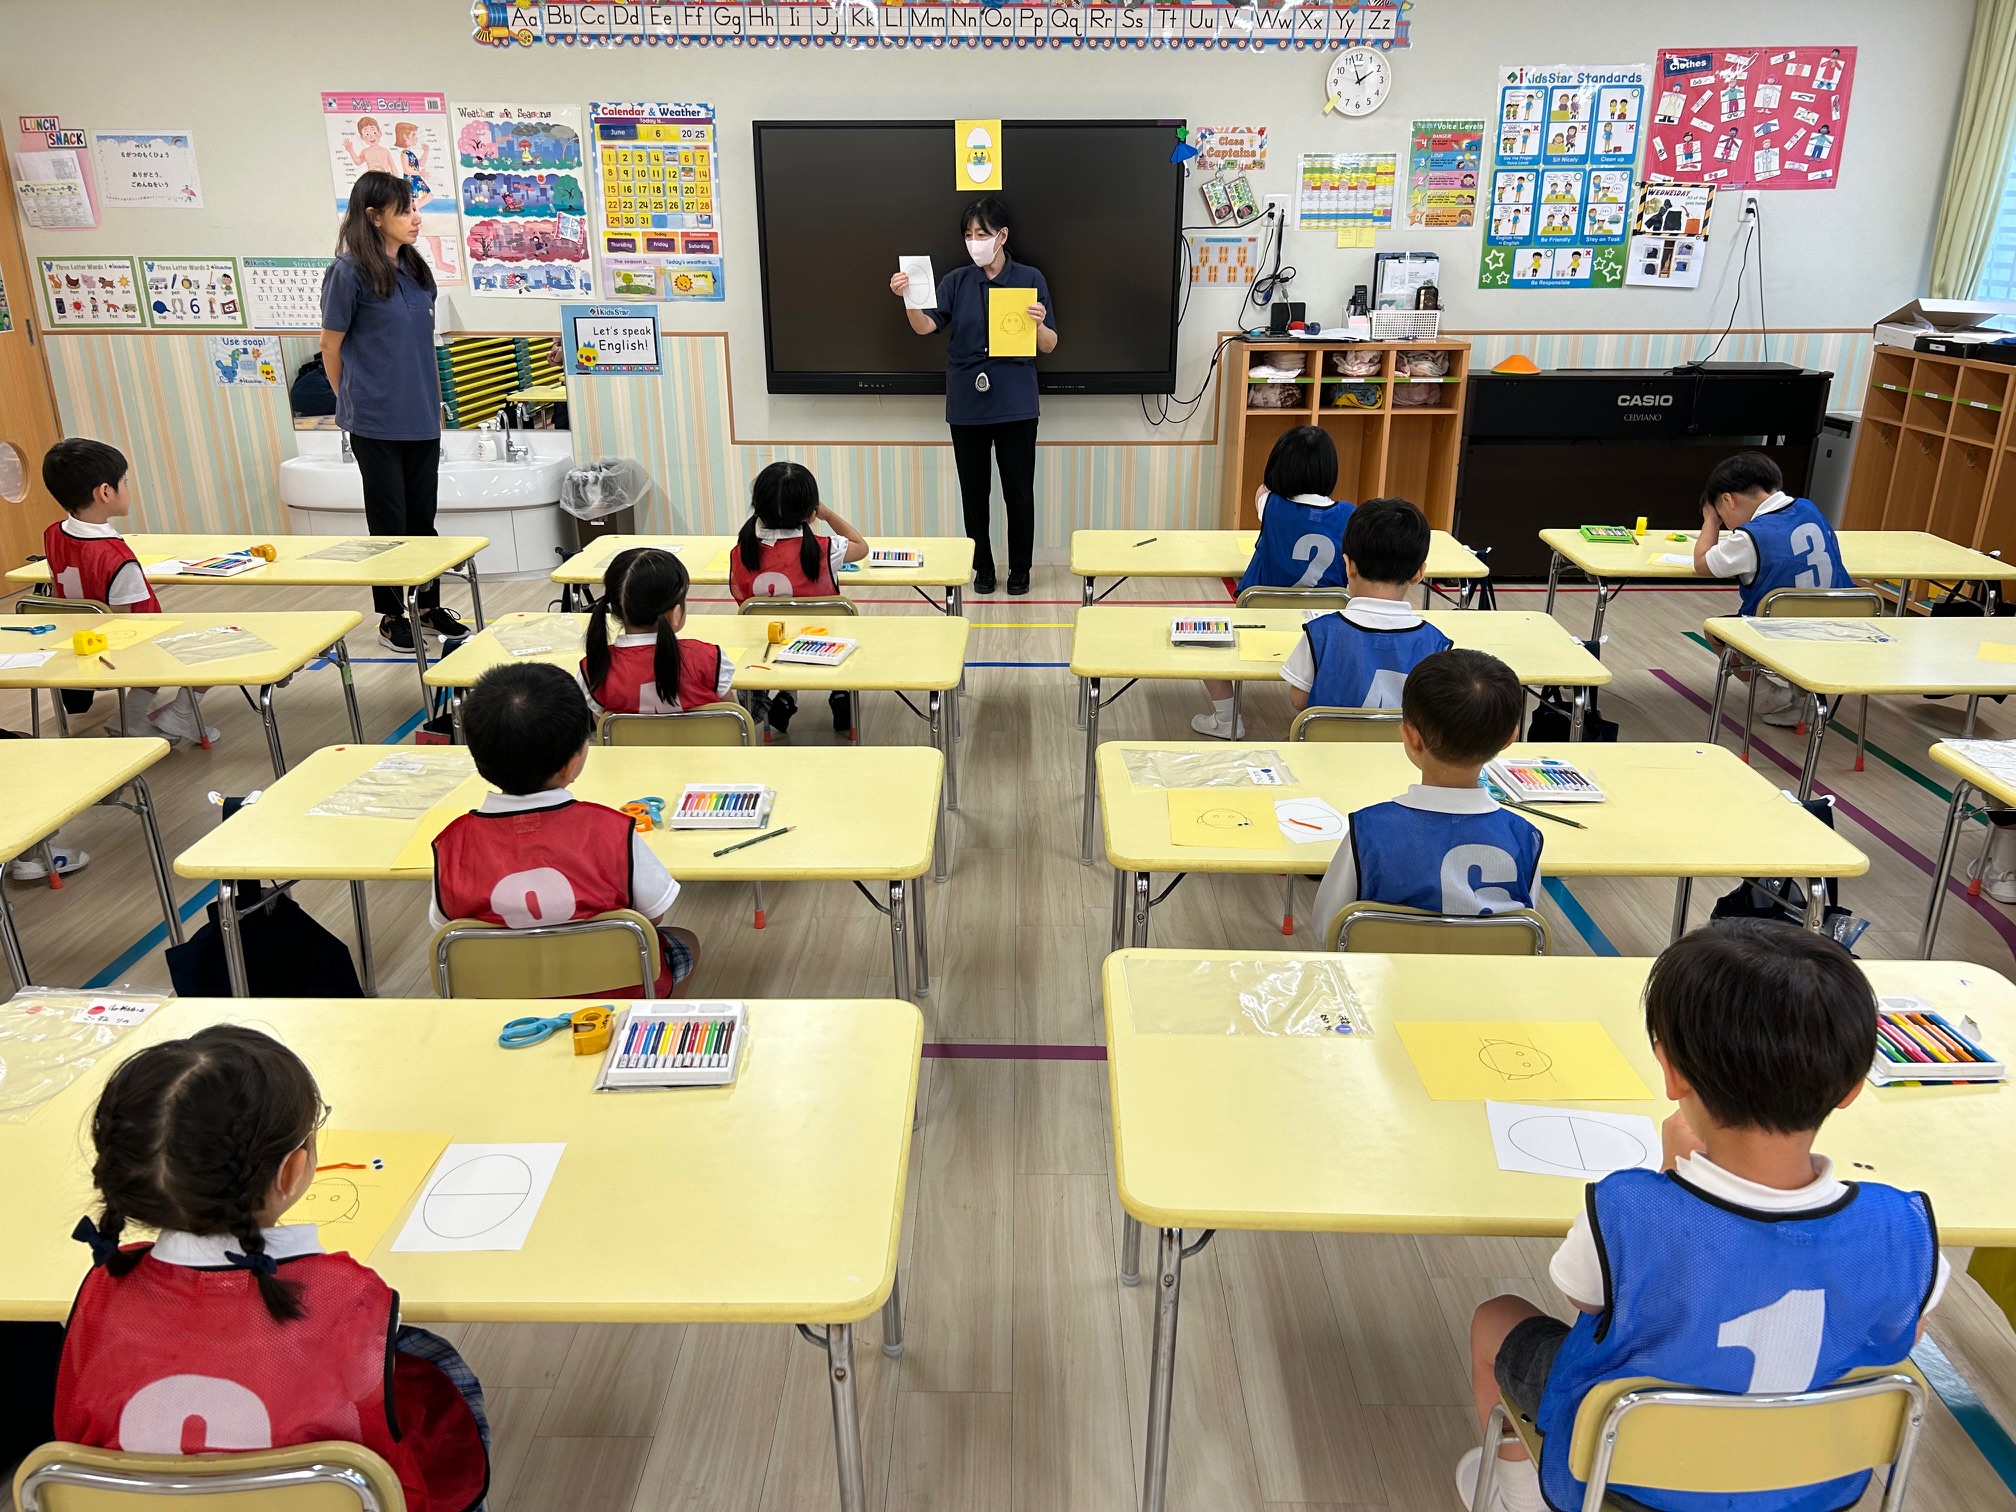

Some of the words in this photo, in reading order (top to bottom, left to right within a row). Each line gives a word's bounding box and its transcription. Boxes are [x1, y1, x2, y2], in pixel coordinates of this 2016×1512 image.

[511, 6, 538, 27] Aa
[547, 5, 573, 25] Bb
[580, 6, 605, 25] Cc
[613, 6, 639, 25] Dd
[651, 6, 672, 26] Ee
[684, 6, 704, 26] Ff
[714, 6, 741, 35] Gg
[748, 6, 774, 27] Hh
[789, 7, 800, 27] Ii
[816, 7, 839, 36] Jj
[852, 7, 875, 27] Kk
[886, 8, 903, 27] Ll
[911, 8, 945, 28] Mm
[952, 8, 977, 28] Nn
[984, 8, 1012, 28] Oo
[1020, 8, 1044, 37] Pp
[1052, 8, 1083, 37] Qq
[1090, 8, 1113, 28] Rr
[1122, 9, 1143, 28] Ss
[1157, 9, 1177, 29] Tt
[1189, 9, 1214, 29] Uu
[1256, 9, 1292, 30] Ww
[1298, 10, 1323, 30] Xx
[1335, 10, 1355, 39] Yy
[1368, 10, 1391, 30] Zz
[1670, 60, 1707, 71] Clothes
[1380, 76, 1383, 84] 3
[1577, 73, 1642, 84] Standards
[352, 98, 372, 112] My
[376, 98, 410, 113] Body
[457, 108, 494, 118] Weather
[518, 108, 551, 118] Seasons
[602, 107, 645, 116] Calendar
[649, 108, 655, 116] &
[659, 108, 700, 116] Weather
[24, 118, 57, 130] LUNCH
[49, 132, 84, 145] SNACK
[1219, 137, 1244, 146] Class
[1207, 147, 1256, 159] Captains
[1648, 189, 1691, 197] WEDNESDAY
[593, 327, 618, 336] Let's
[623, 326, 652, 337] speak
[243, 338, 266, 347] soap!
[599, 340, 648, 353] English!
[1618, 395, 1673, 406] CASIO
[1292, 533, 1336, 588] 2
[1790, 523, 1833, 588] 3
[1717, 1289, 1825, 1393] 1
